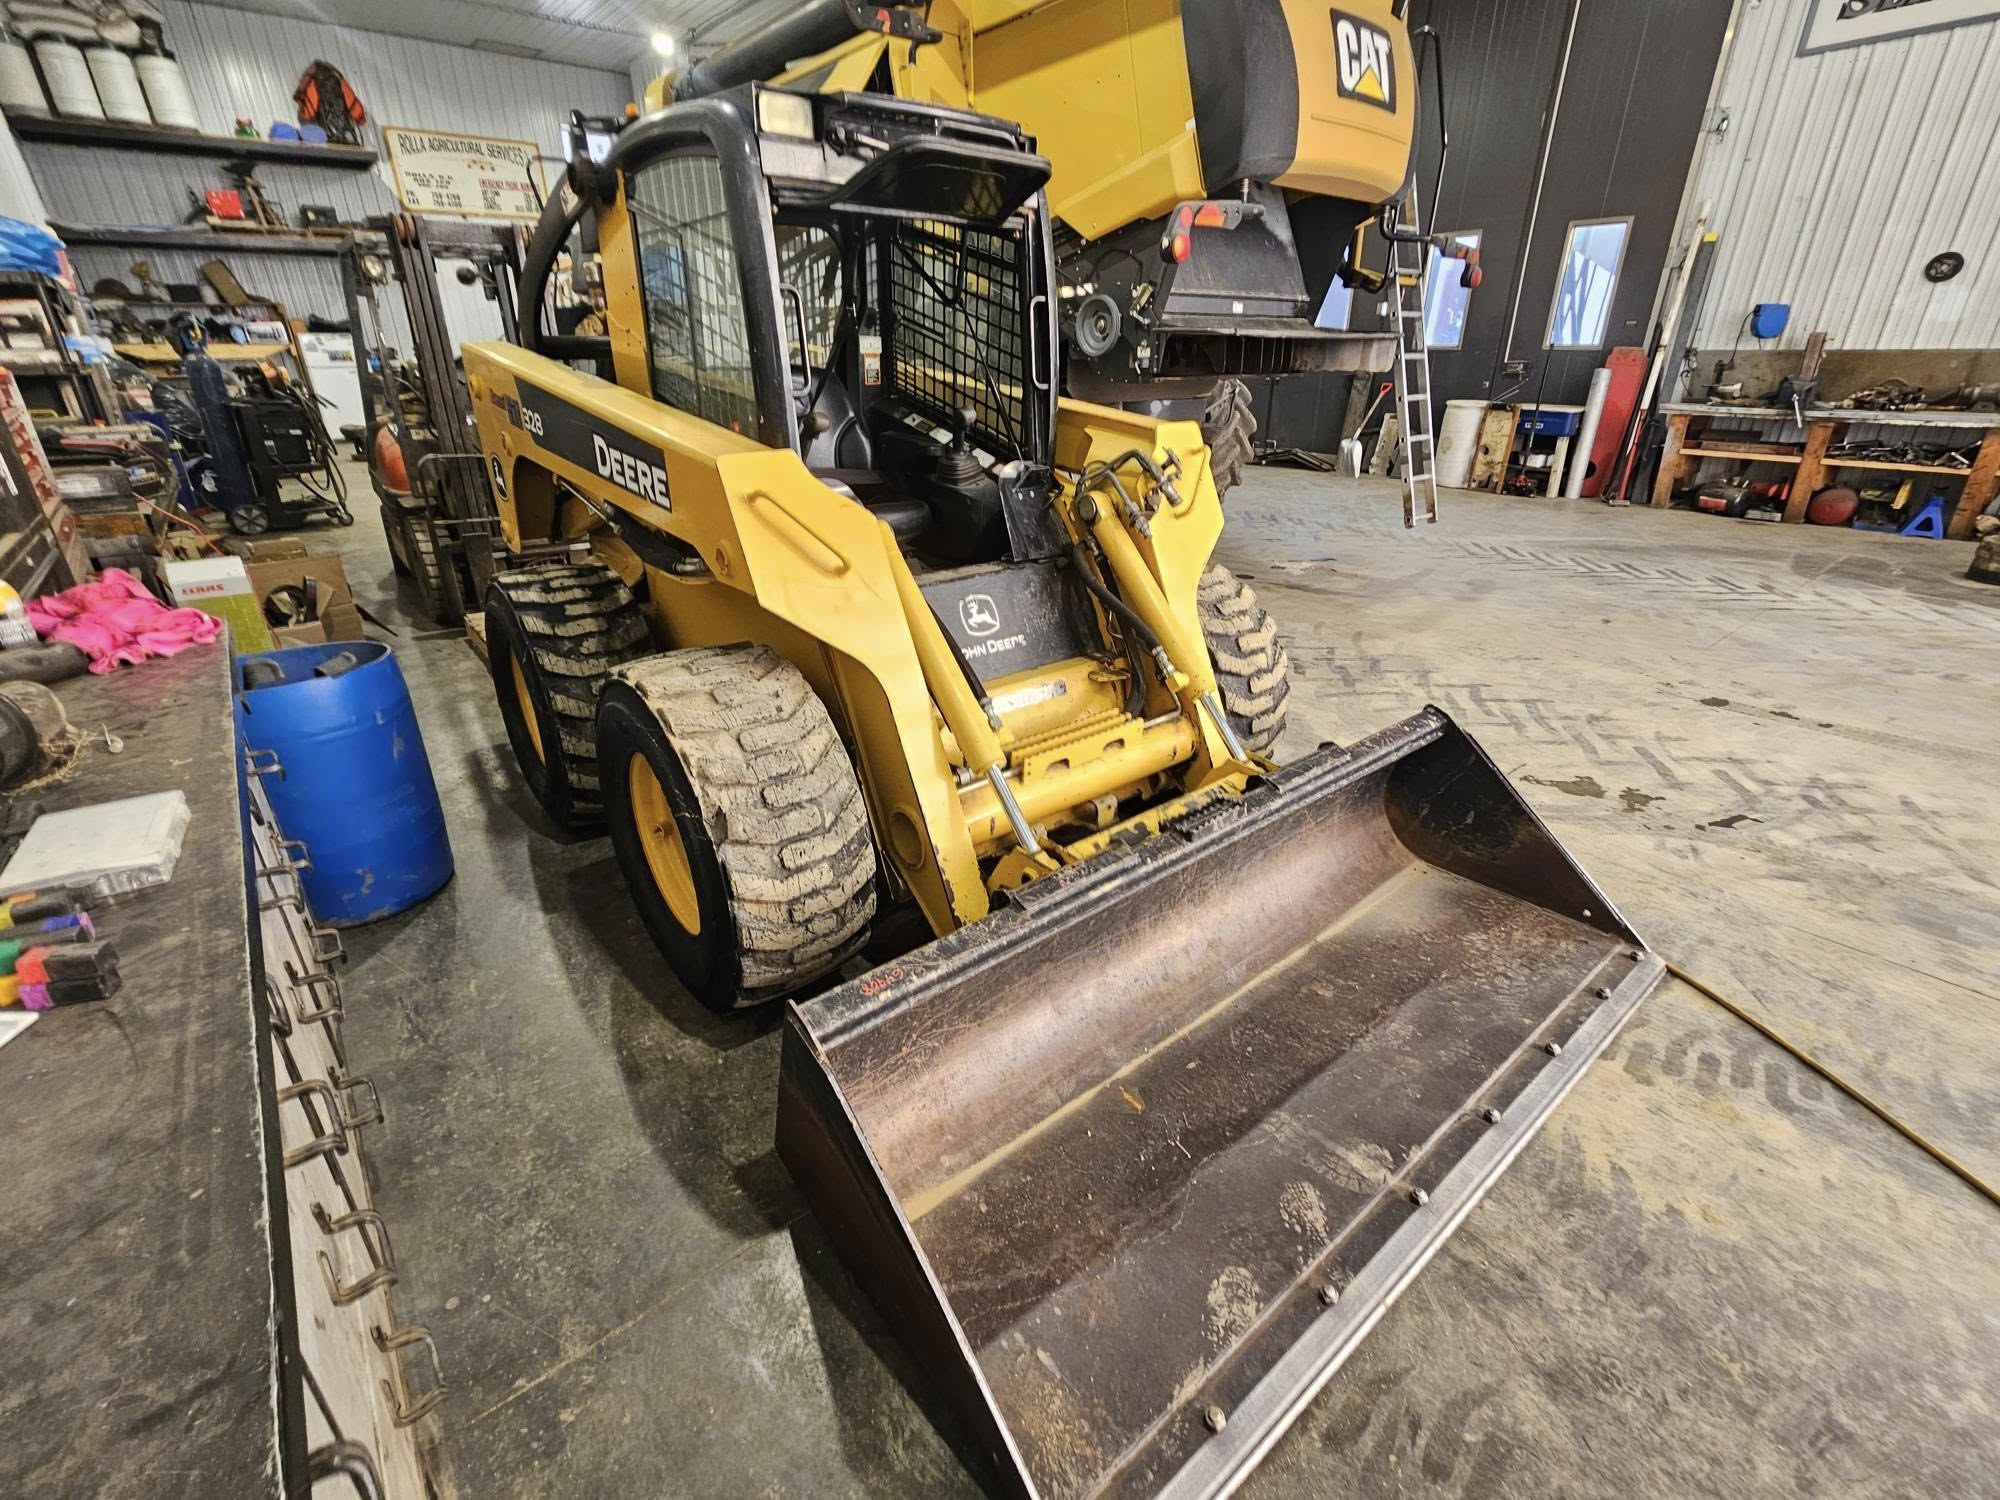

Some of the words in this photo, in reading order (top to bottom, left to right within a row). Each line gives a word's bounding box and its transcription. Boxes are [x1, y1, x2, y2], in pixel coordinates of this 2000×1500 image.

[1336, 19, 1390, 105] CAT
[398, 133, 427, 156] ROLLA
[428, 138, 484, 157] AGRICULTURAL
[486, 144, 526, 168] SERVICES
[522, 407, 543, 437] 328
[592, 433, 671, 509] DEERE
[961, 643, 987, 660] OHN
